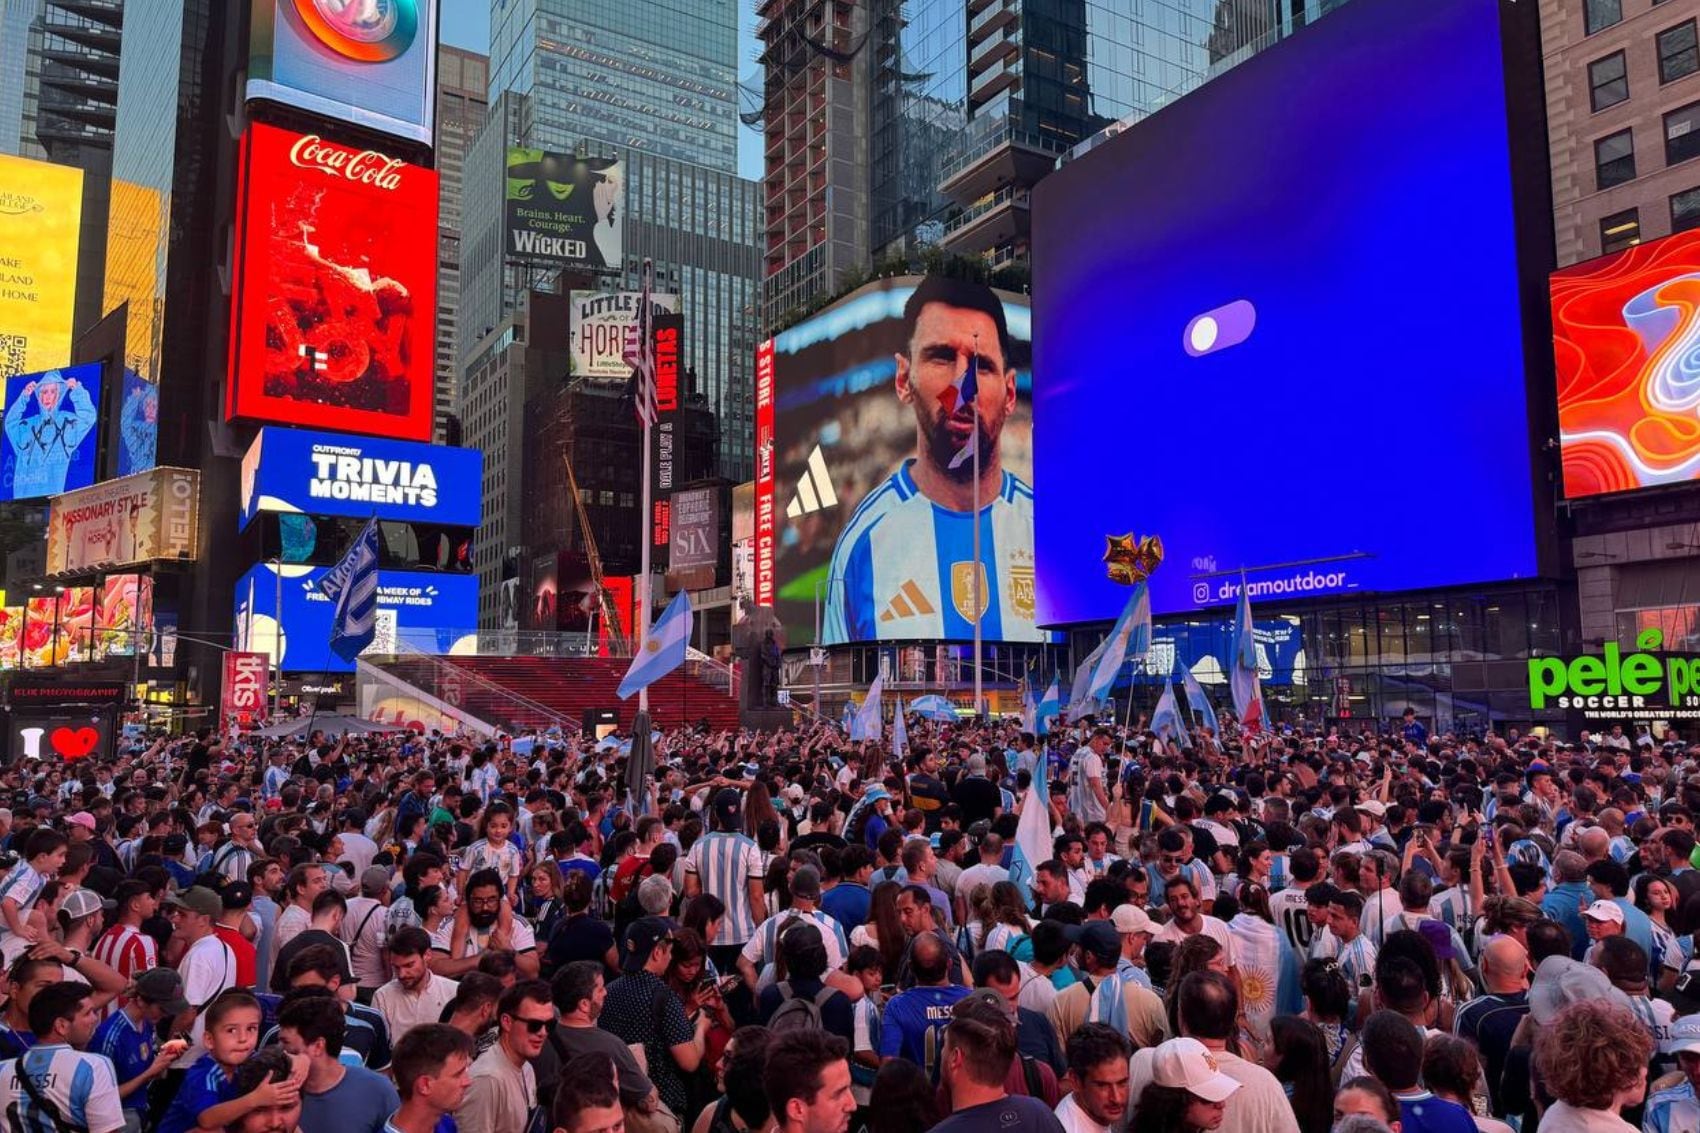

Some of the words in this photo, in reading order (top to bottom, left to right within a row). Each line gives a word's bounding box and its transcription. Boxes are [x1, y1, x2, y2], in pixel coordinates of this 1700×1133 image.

[290, 135, 407, 190] Coca-Cola
[517, 208, 552, 220] Brains.
[555, 212, 585, 224] Heart.
[529, 219, 573, 233] Courage.
[2, 289, 38, 302] HOME
[581, 295, 632, 320] LITTLE
[758, 354, 772, 409] STORE
[311, 452, 438, 489] TRIVIA
[309, 478, 438, 507] MOMENTS
[62, 499, 117, 523] MISSIONARY
[760, 494, 772, 532] FREE
[759, 535, 773, 607] CHOCOL
[385, 588, 408, 596] WEEK
[410, 588, 422, 596] OF
[405, 597, 432, 606] RIDES
[233, 656, 264, 707] tkts
[1528, 628, 1664, 709] pelé
[1558, 696, 1645, 708] SOCCER
[1284, 908, 1313, 948] 10
